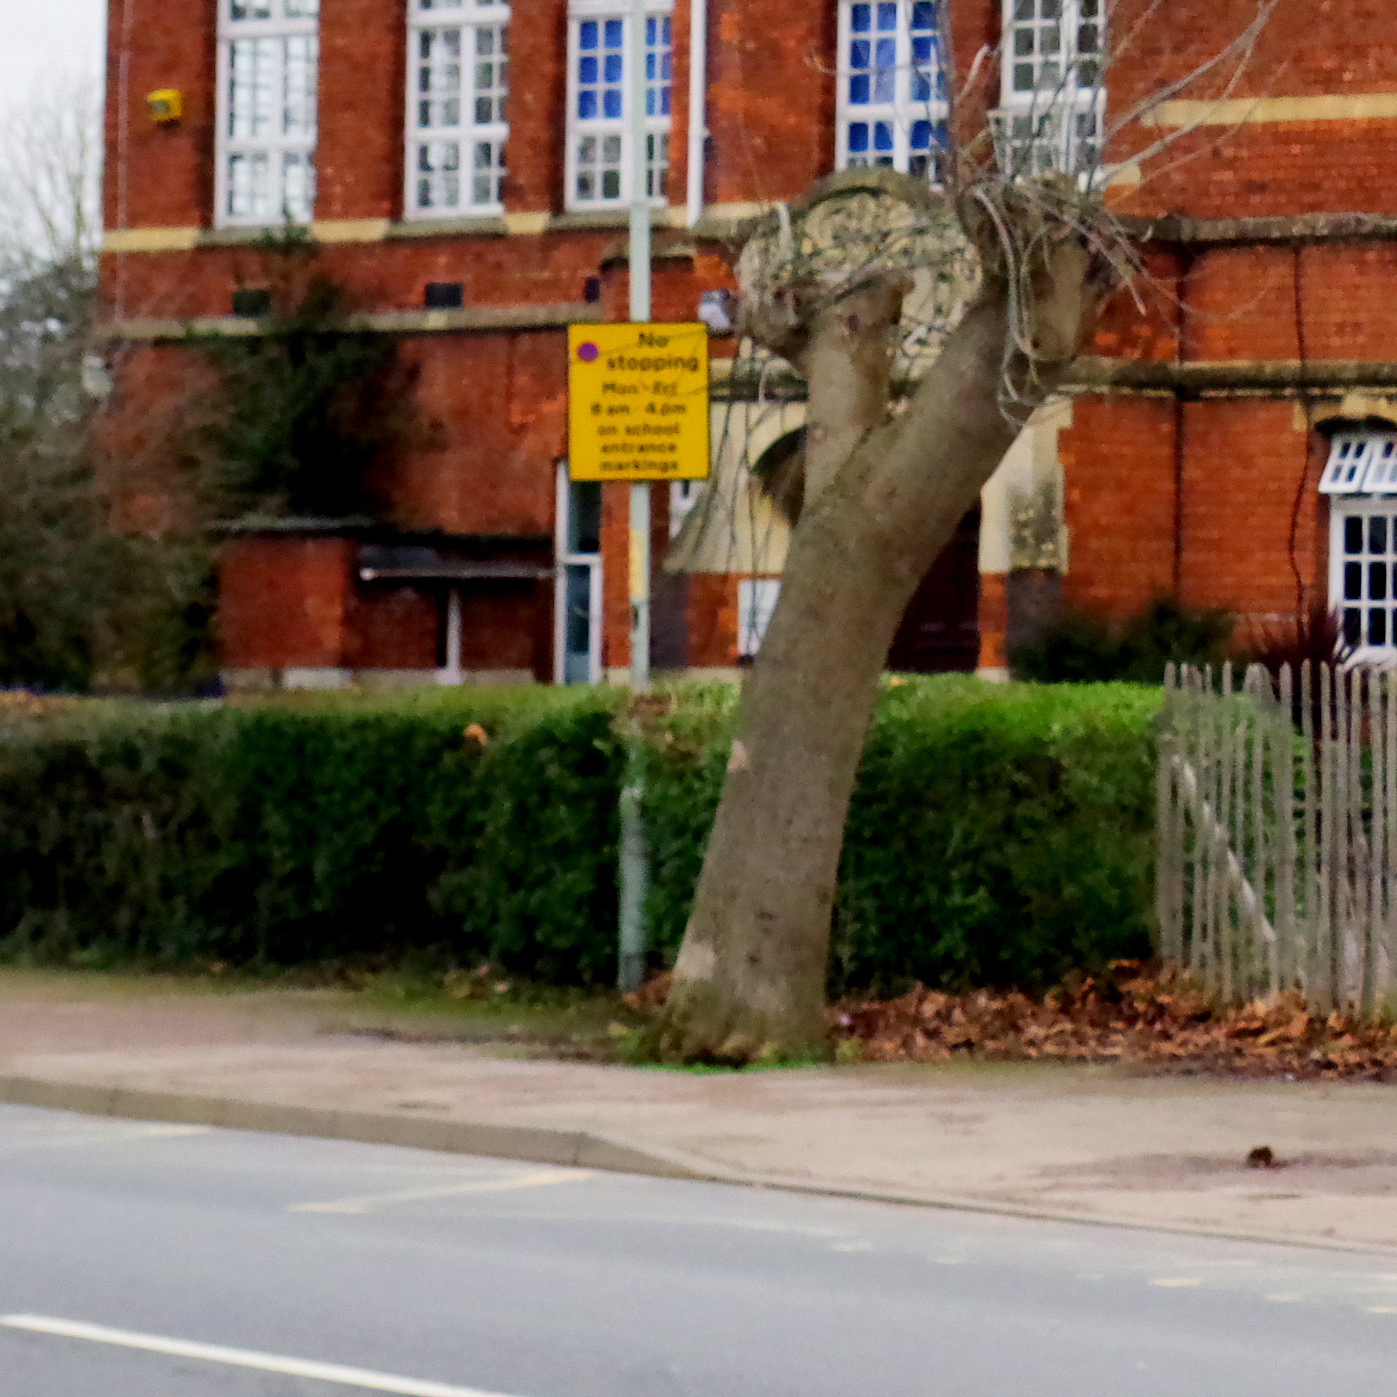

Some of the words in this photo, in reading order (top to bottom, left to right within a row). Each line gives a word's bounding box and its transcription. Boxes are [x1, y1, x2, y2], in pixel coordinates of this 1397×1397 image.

[638, 332, 669, 348] No
[607, 356, 699, 372] stopping
[602, 381, 639, 394] Mon
[652, 381, 678, 396] Fri
[625, 422, 680, 437] school
[601, 442, 677, 454] entrance
[600, 459, 678, 473] markings
